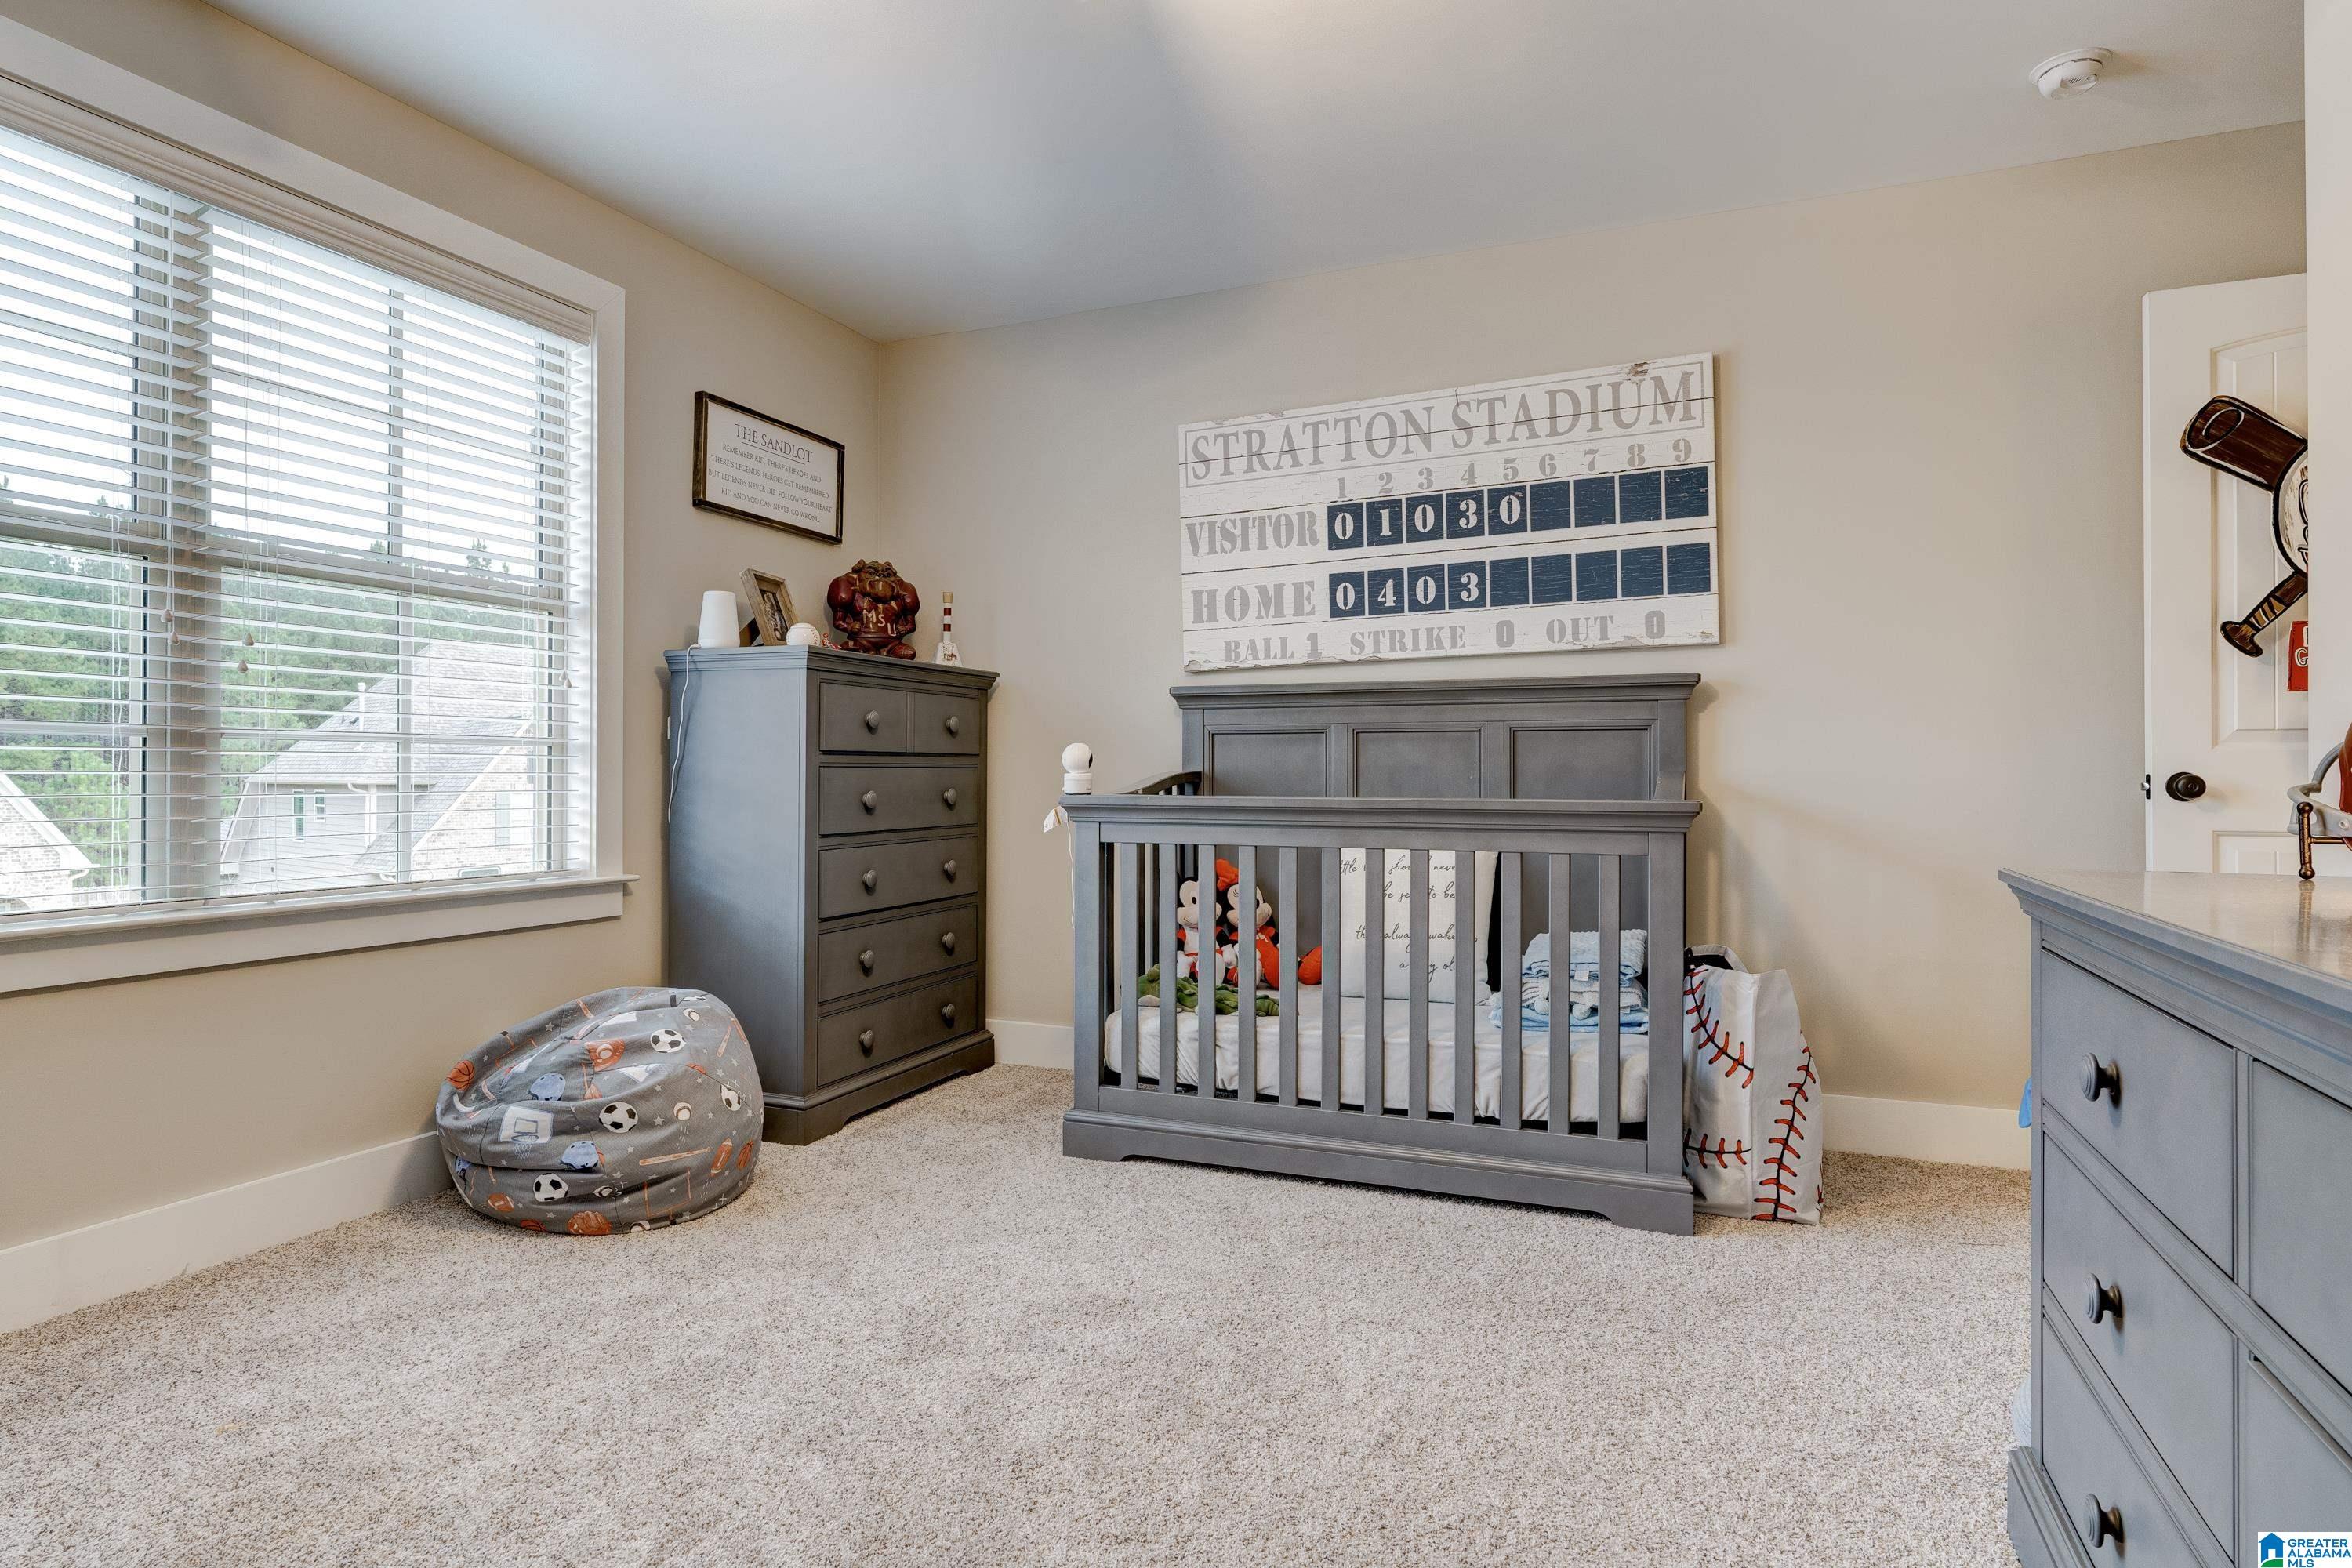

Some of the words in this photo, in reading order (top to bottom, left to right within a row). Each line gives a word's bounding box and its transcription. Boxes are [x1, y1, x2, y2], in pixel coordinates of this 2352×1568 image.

[735, 423, 758, 444] THE
[761, 434, 813, 463] SANDLOT
[1192, 406, 1434, 480] STRATTON
[1451, 370, 1697, 449] STADIUM
[723, 444, 753, 460] REMEMBER
[789, 466, 808, 479] HEROES
[810, 474, 822, 483] AND
[763, 471, 783, 484] HEROES
[784, 479, 794, 488] GET
[1337, 477, 1347, 498] 1
[1378, 472, 1393, 494] 2
[1418, 467, 1433, 490] 3
[1461, 462, 1478, 485] 4
[1503, 457, 1519, 481] 5
[1539, 453, 1557, 477] 6
[1584, 448, 1599, 471] 7
[1627, 443, 1645, 468] 8
[1672, 438, 1692, 463] 9
[709, 468, 720, 478] BUT
[721, 472, 746, 486] LEGENDS
[748, 481, 765, 493] NEVER
[779, 490, 798, 503] FOLLOW
[800, 499, 815, 508] YOUR
[816, 503, 832, 513] HEART
[721, 487, 731, 496] KID
[734, 492, 746, 500] AND
[747, 495, 759, 504] YOU
[760, 499, 771, 508] CAN
[773, 503, 790, 514] NEVER
[791, 508, 799, 517] GO
[1185, 510, 1319, 557] VISITOR
[1334, 512, 1354, 540] 0
[1380, 509, 1392, 536] 1
[1415, 504, 1435, 533] 0
[1459, 499, 1478, 529] 3
[1499, 495, 1521, 524] 0
[1191, 580, 1316, 624] HOME
[1336, 583, 1356, 610] 0
[1378, 579, 1396, 607] 4
[1416, 575, 1436, 604] 0
[1461, 572, 1479, 601] 3
[1224, 636, 1294, 662] BALL
[1306, 633, 1323, 659] 1
[1349, 625, 1466, 655] STRIKE
[1496, 619, 1515, 648] 0
[1546, 615, 1613, 644] OUT
[1645, 610, 1665, 639] 0
